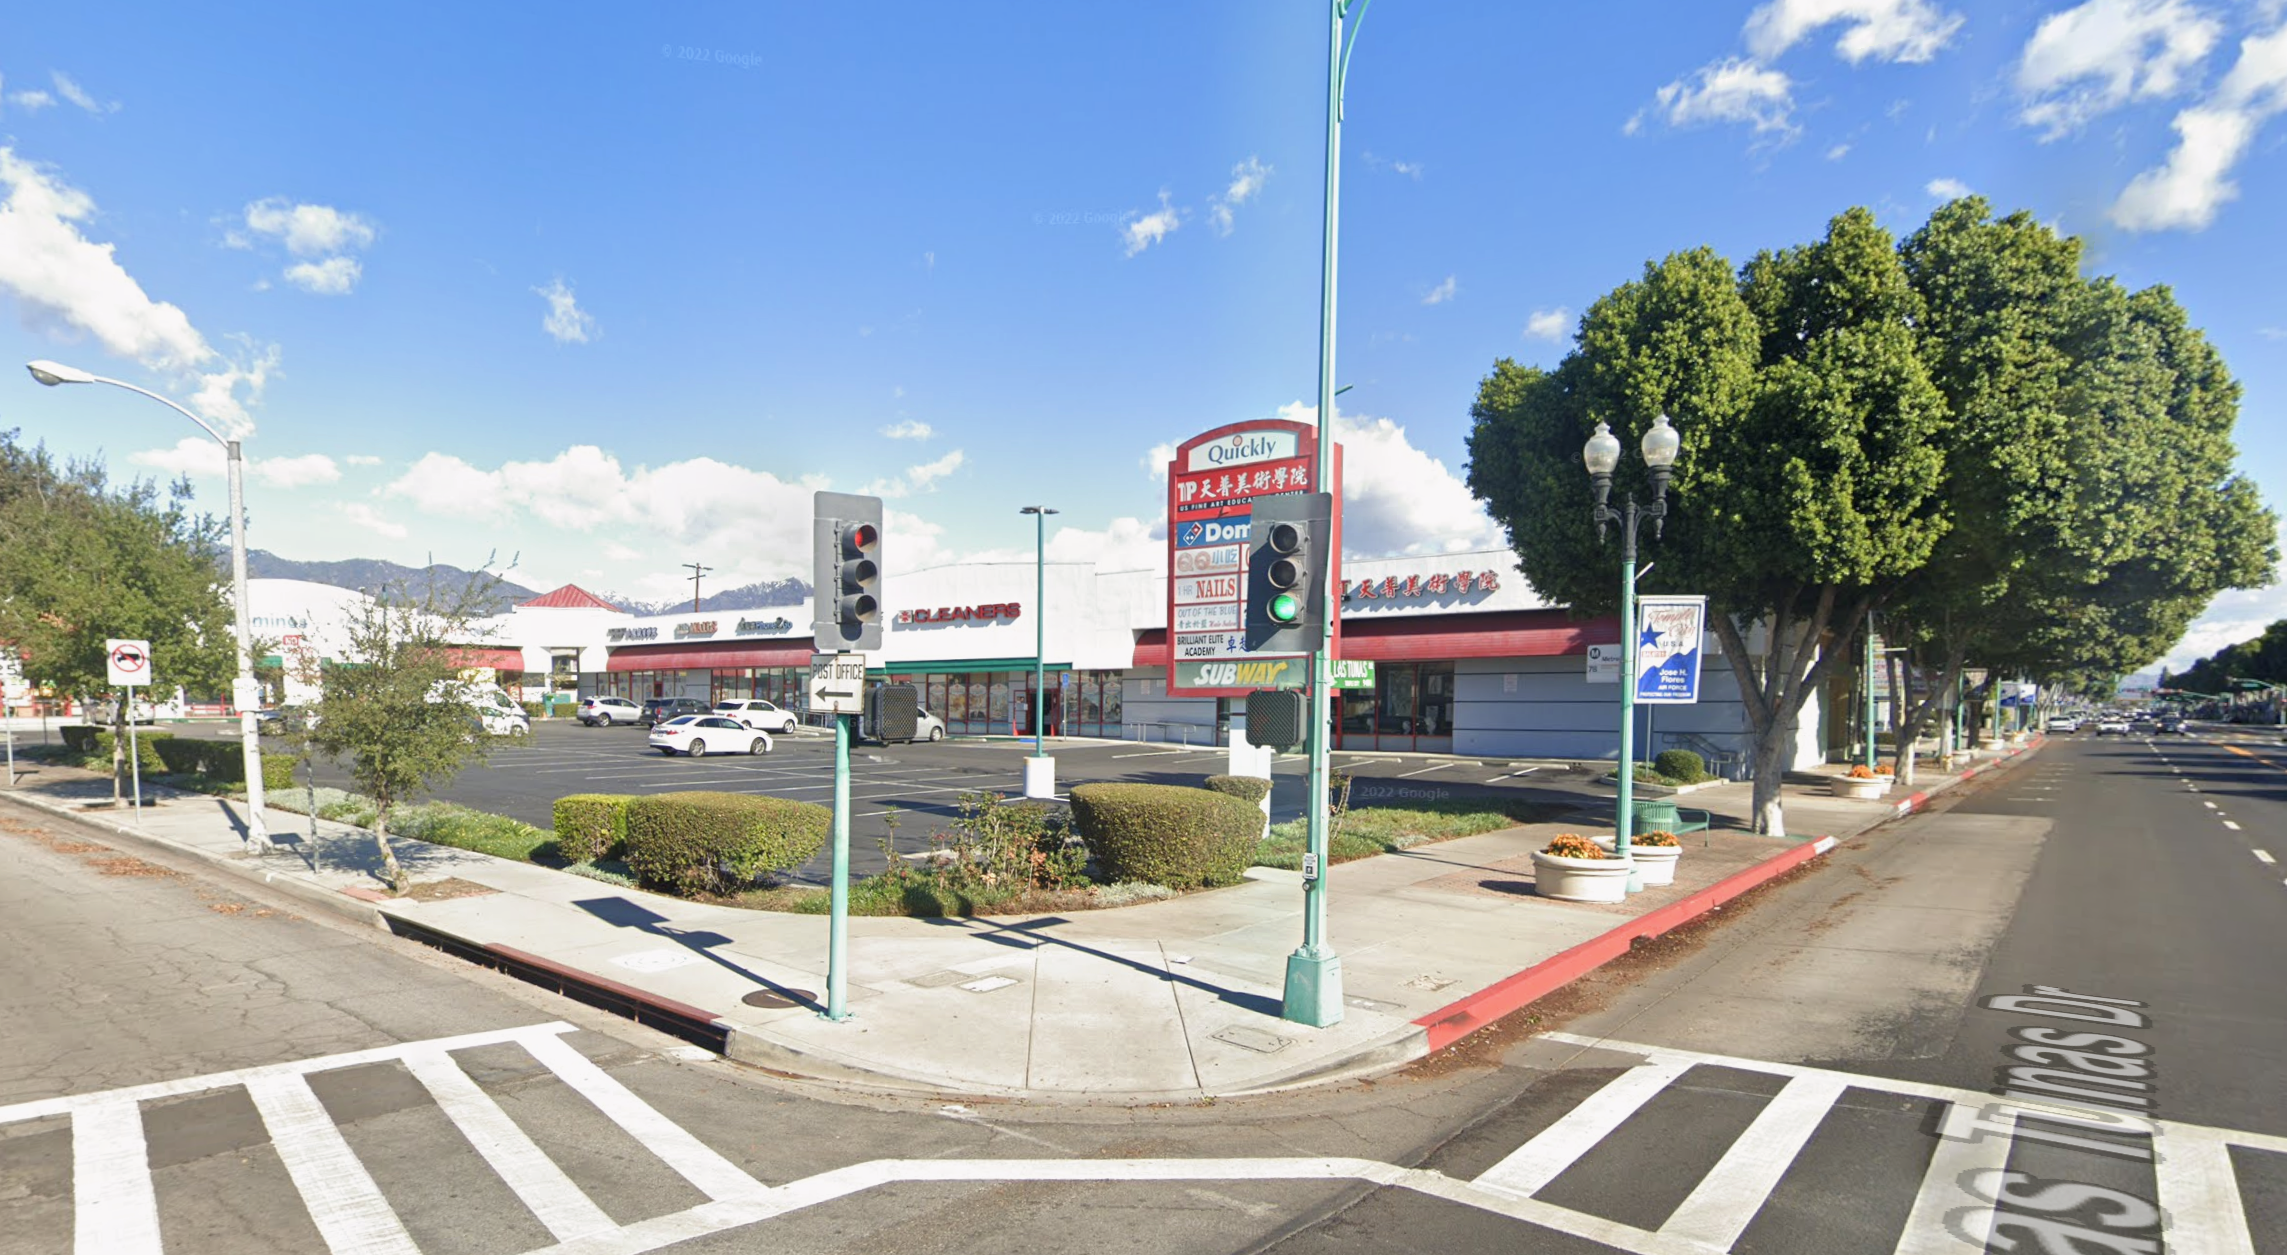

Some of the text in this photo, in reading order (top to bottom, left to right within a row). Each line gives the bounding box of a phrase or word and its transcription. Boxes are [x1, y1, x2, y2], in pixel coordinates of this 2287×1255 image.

[1208, 436, 1277, 465] Quickly
[1200, 465, 1308, 499] 天普美術學院
[1180, 504, 1189, 512] US
[1191, 502, 1207, 510] FINE
[1210, 500, 1224, 508] ART
[1205, 522, 1251, 542] Dom
[1183, 585, 1192, 595] HR
[1196, 578, 1236, 599] NAILS
[1358, 569, 1502, 600] 天普美術學院
[914, 602, 1021, 624] CLEANERS
[1178, 605, 1237, 618] OUT OF THE BLUE
[1177, 635, 1207, 646] BRILLIANT
[1208, 634, 1224, 644] ELITE
[1185, 646, 1216, 657] ACADEMY
[812, 664, 863, 680] POST OFFICE
[1193, 661, 1289, 687] SUBWAY
[1659, 668, 1678, 676] Jose
